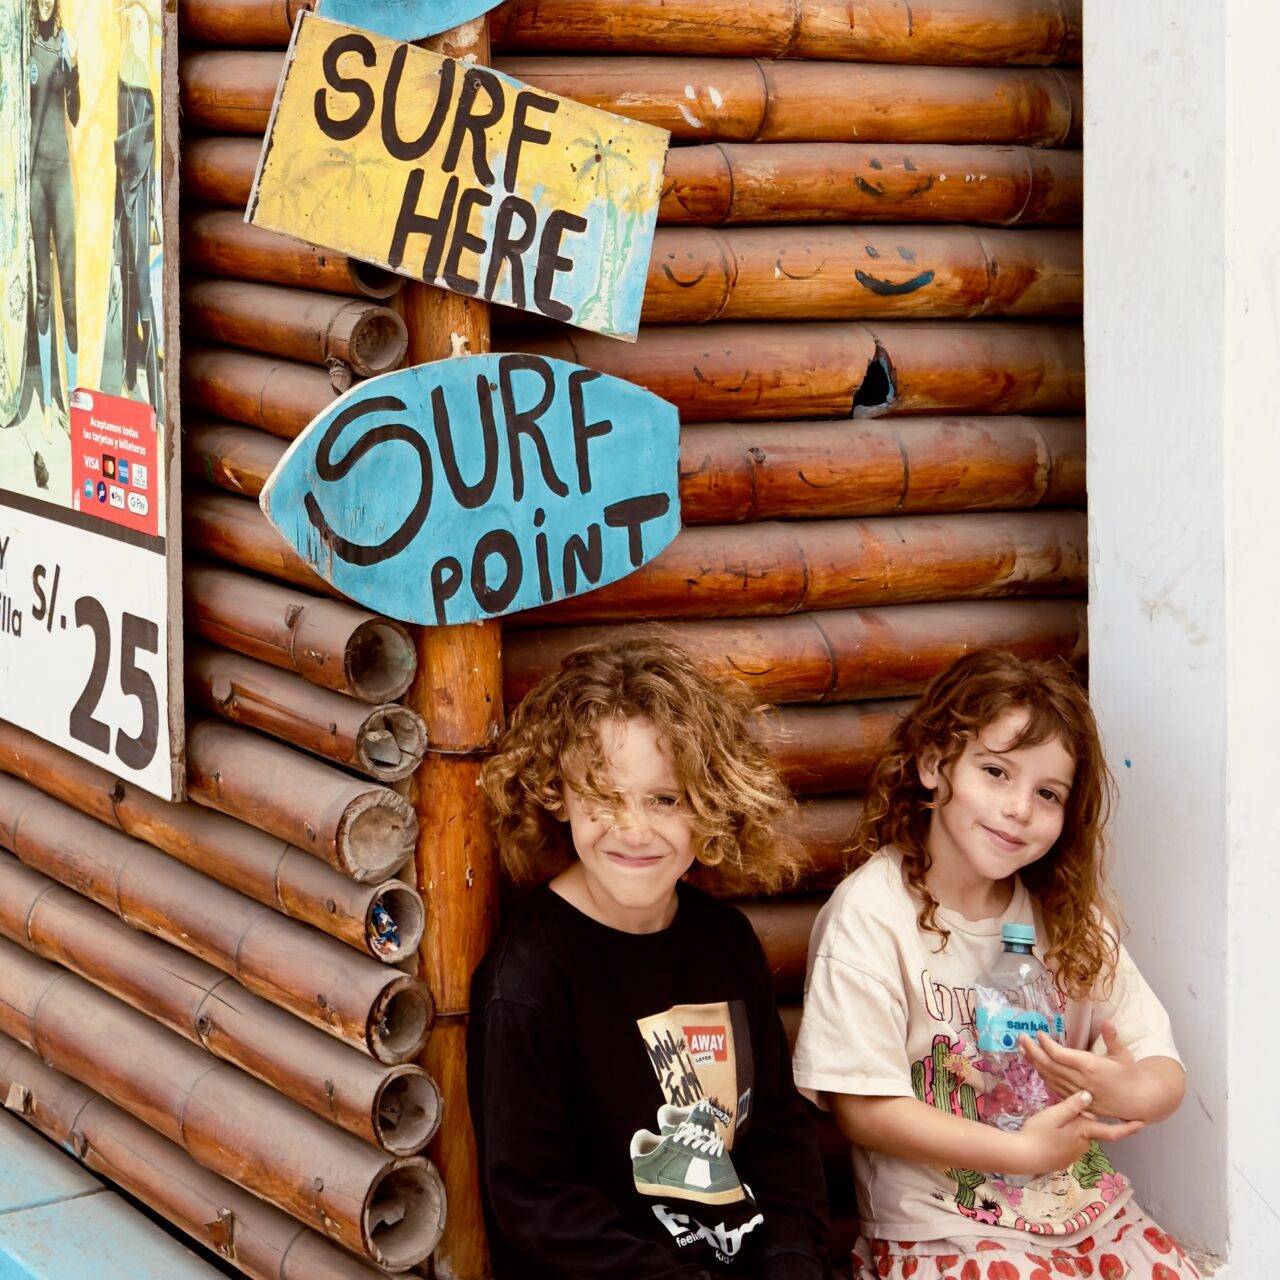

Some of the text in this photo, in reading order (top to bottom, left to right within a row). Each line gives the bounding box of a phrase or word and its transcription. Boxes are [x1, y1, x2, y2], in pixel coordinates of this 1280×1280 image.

[314, 34, 559, 193] SURF
[388, 168, 587, 321] HERE
[83, 455, 100, 471] VISA
[90, 417, 122, 435] Aceptamos
[305, 354, 613, 566] SURF
[32, 564, 159, 770] S/. 25
[691, 1034, 725, 1051] AWAY
[1007, 1021, 1029, 1031] san
[1030, 1020, 1049, 1033] luis
